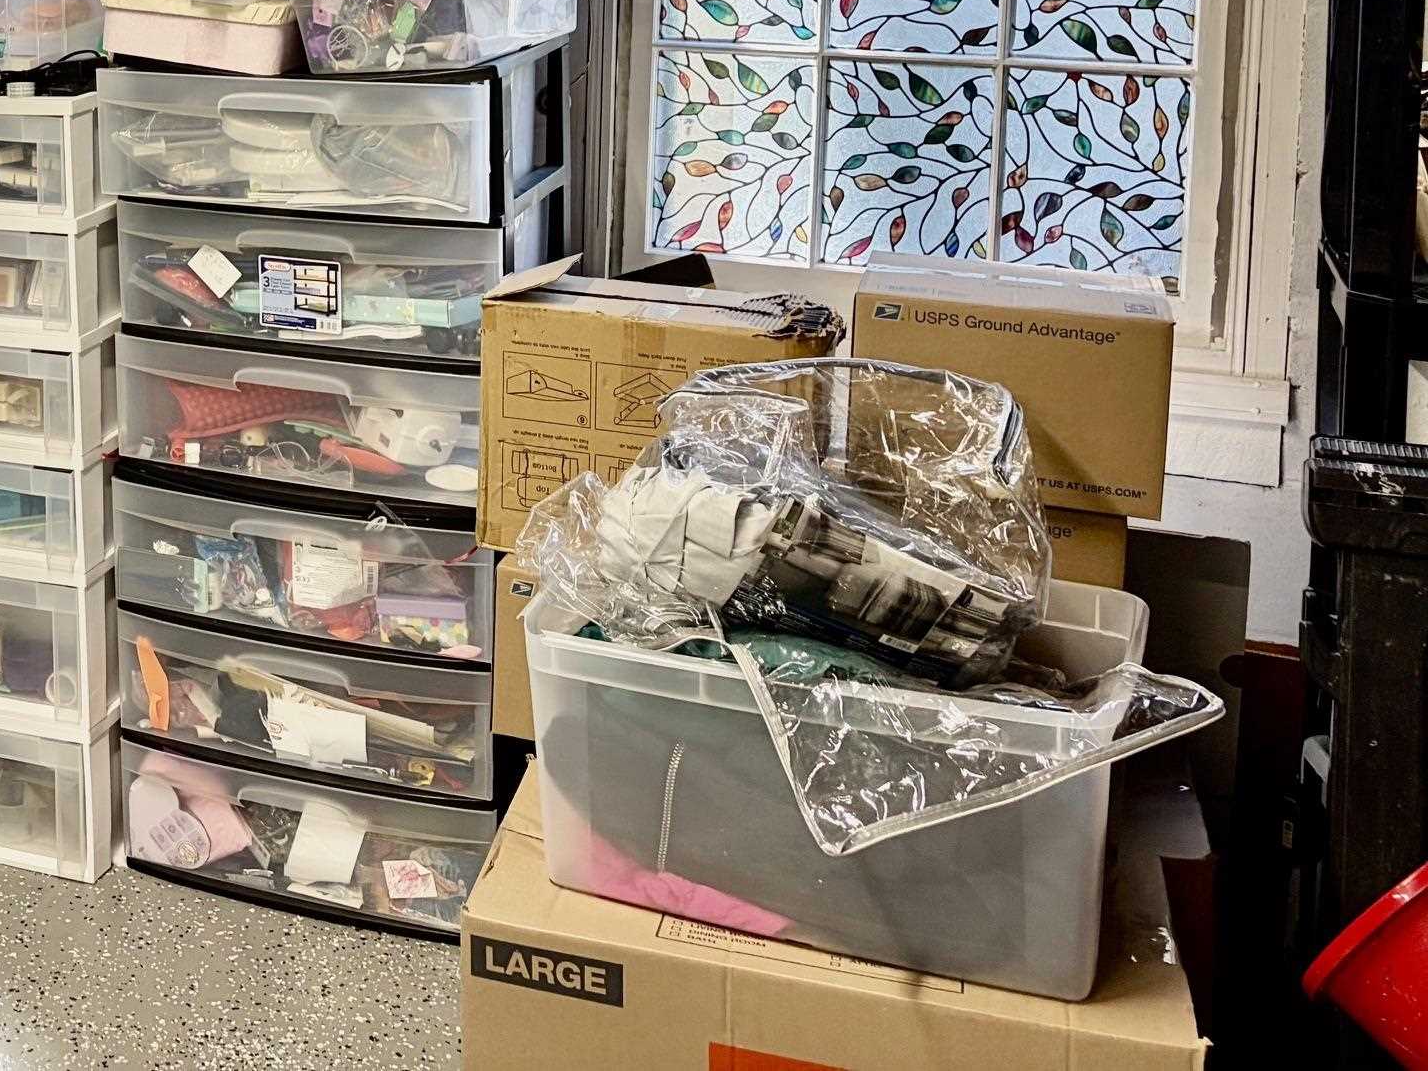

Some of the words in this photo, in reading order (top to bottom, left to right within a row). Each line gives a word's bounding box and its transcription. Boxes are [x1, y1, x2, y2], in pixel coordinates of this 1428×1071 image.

[262, 276, 270, 287] 3
[914, 310, 960, 327] USPS
[964, 315, 1023, 334] Ground
[533, 462, 557, 472] Bottom
[1049, 479, 1065, 489] US
[1066, 482, 1079, 490] AT
[536, 485, 550, 496] Top
[484, 945, 608, 996] LARGE
